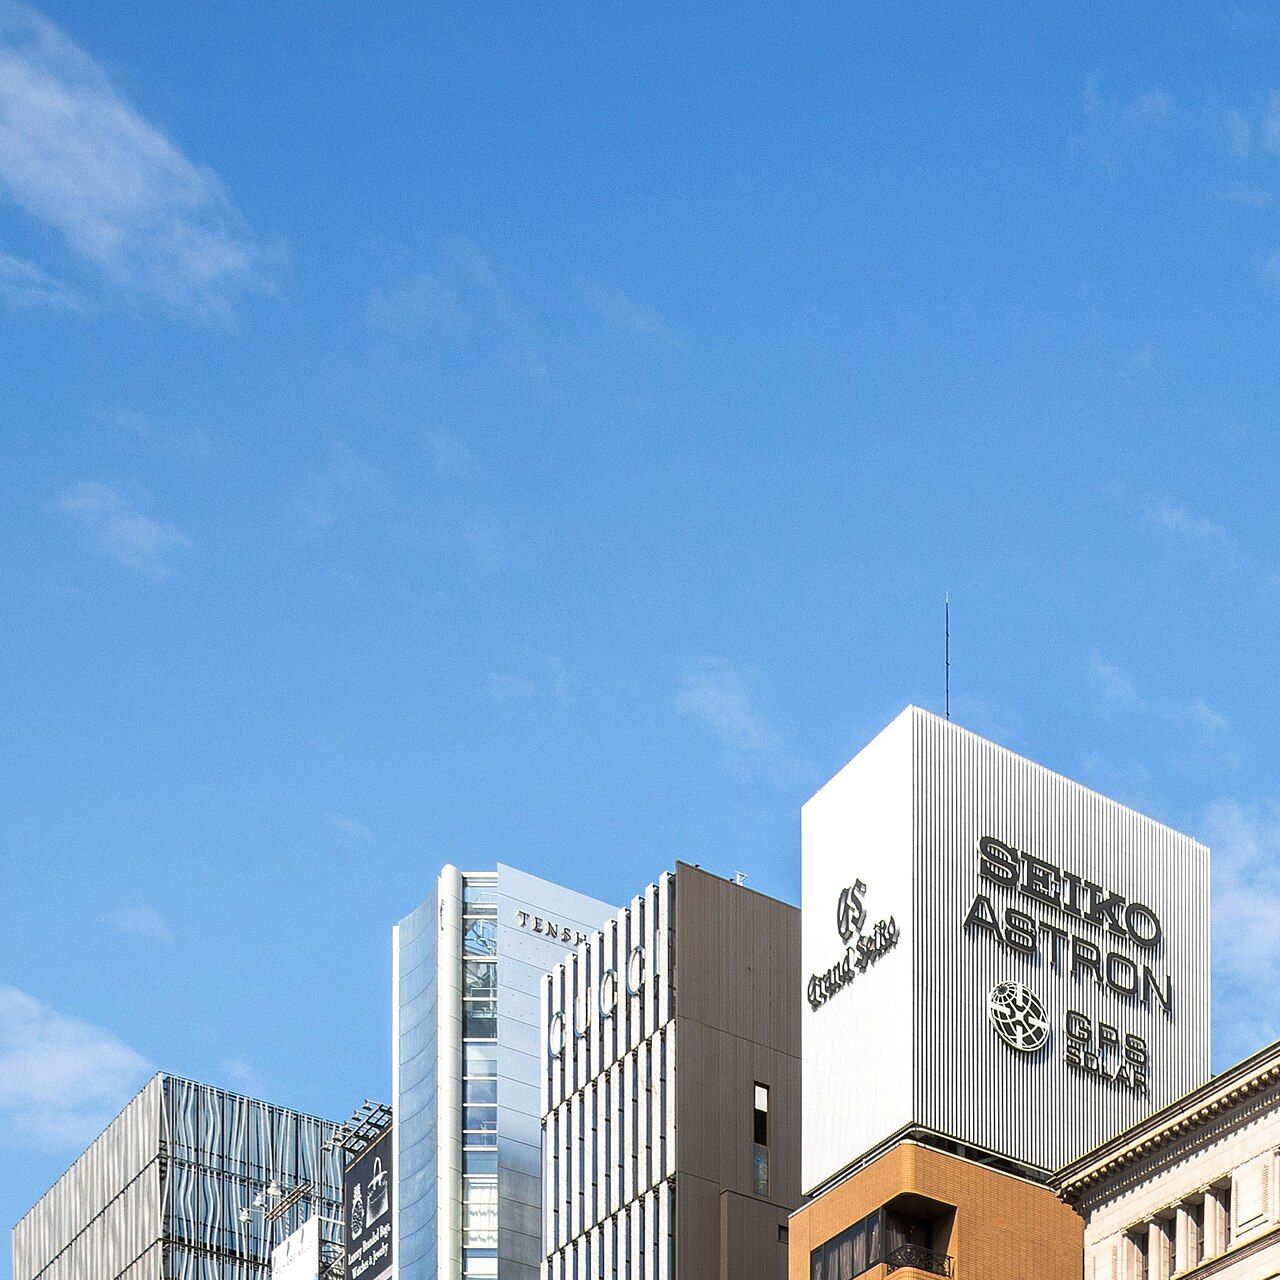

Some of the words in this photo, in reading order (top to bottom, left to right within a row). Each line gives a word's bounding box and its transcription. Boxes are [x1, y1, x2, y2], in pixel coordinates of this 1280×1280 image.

[977, 835, 1162, 949] SEIKO
[807, 945, 856, 1007] Grand
[855, 915, 900, 971] Seiko
[963, 893, 1173, 1016] ASTRON
[1064, 1044, 1149, 1094] SOLAR
[1065, 1009, 1148, 1067] GPS
